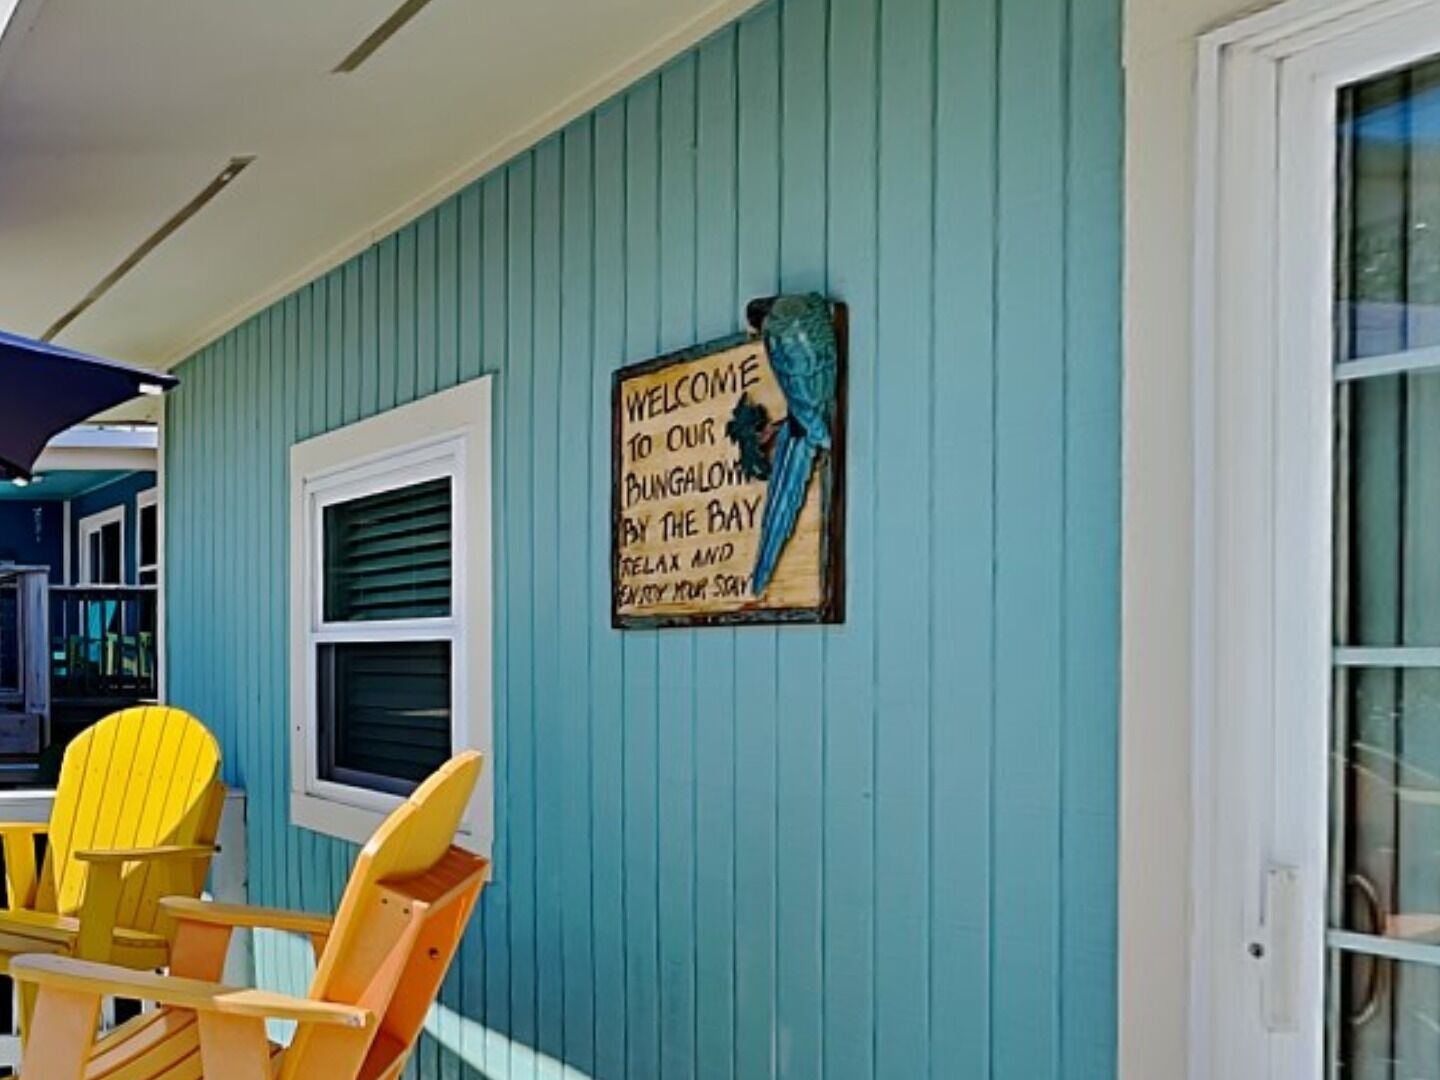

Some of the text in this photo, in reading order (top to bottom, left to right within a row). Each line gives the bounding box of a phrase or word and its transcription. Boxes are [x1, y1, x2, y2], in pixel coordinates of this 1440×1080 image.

[626, 354, 760, 423] WELCOME
[627, 418, 716, 462] TO OUR
[622, 494, 762, 547] BY THE BAY
[620, 542, 734, 578] RELAX AND
